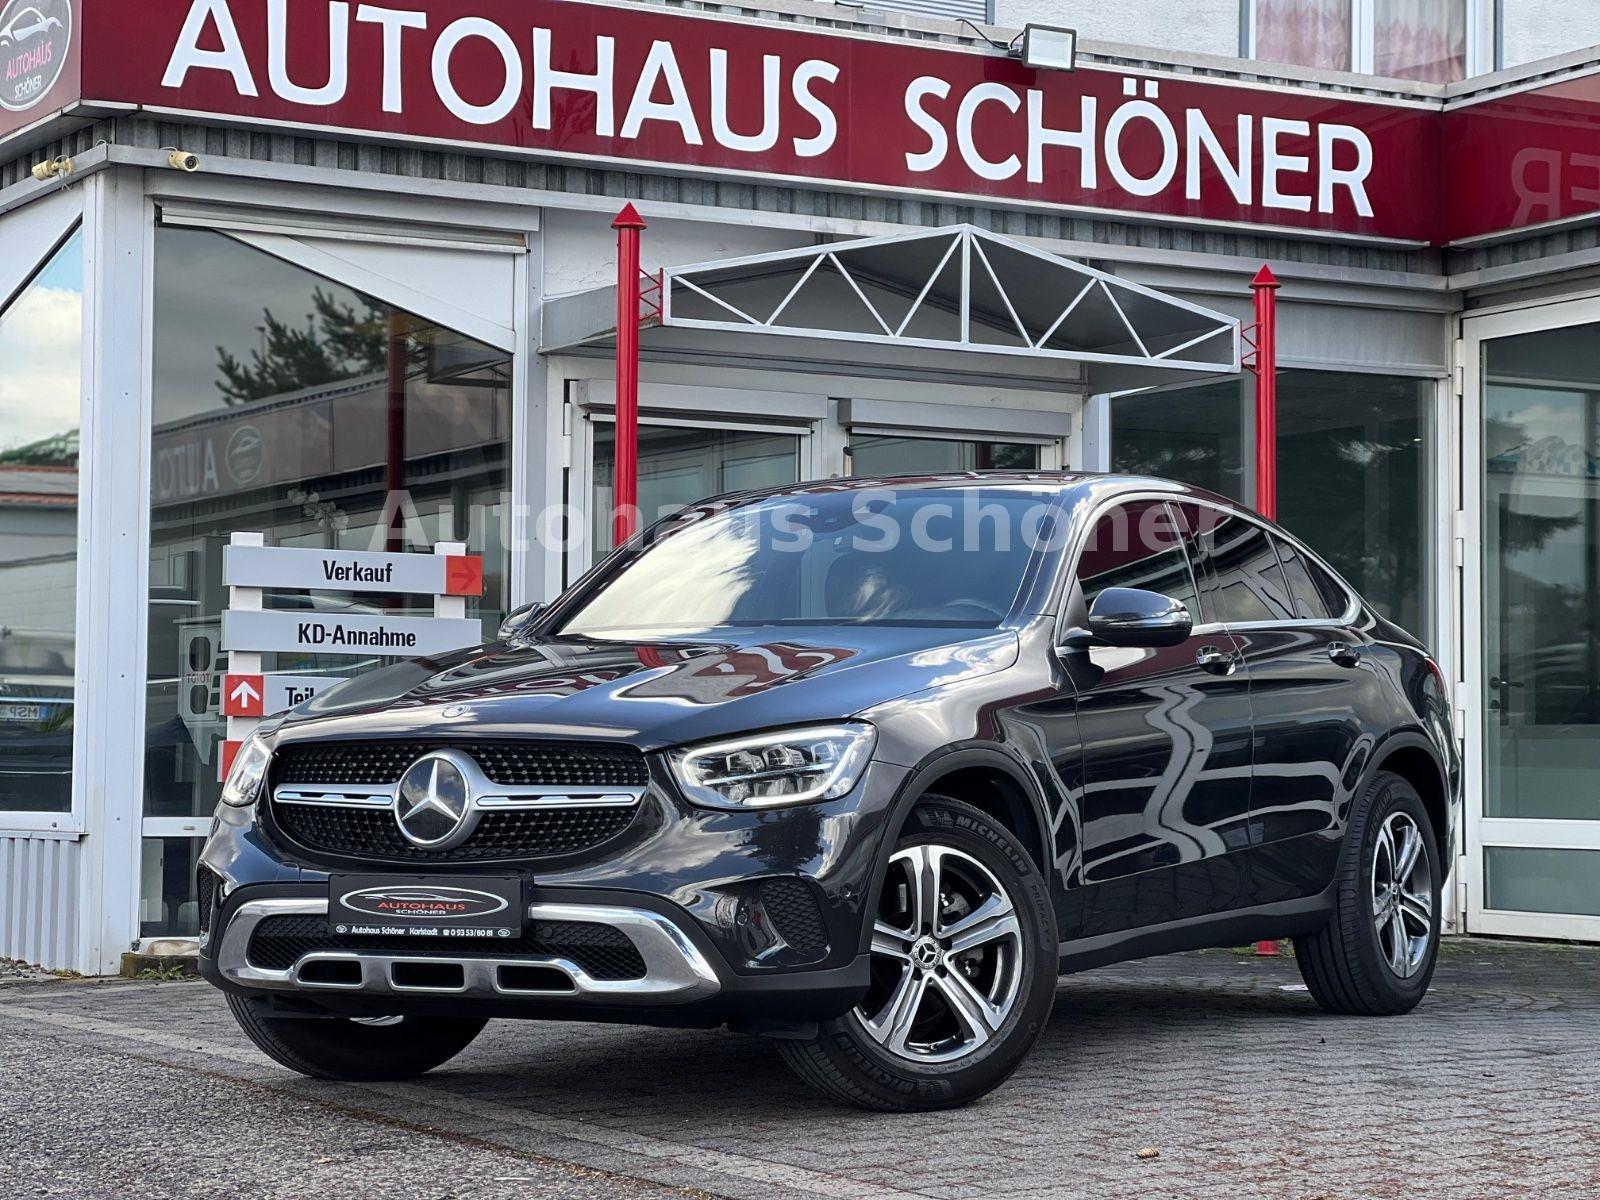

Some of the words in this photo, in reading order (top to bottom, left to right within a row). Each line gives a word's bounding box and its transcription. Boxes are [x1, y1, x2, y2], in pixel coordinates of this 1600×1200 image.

[6, 40, 52, 80] AUTOHAUS
[15, 74, 42, 99] SCHÖNER
[160, 0, 840, 157] AUTOHAUS
[904, 76, 1374, 217] SCHÖNER
[322, 560, 393, 583] Verkauf
[298, 623, 417, 647] KD-Annahme
[956, 814, 1028, 874] MICHELIN
[378, 901, 466, 911] AUTOHAUS
[351, 925, 380, 934] Autohaus
[381, 926, 406, 935] Schöner
[409, 927, 438, 936] Karlstadt
